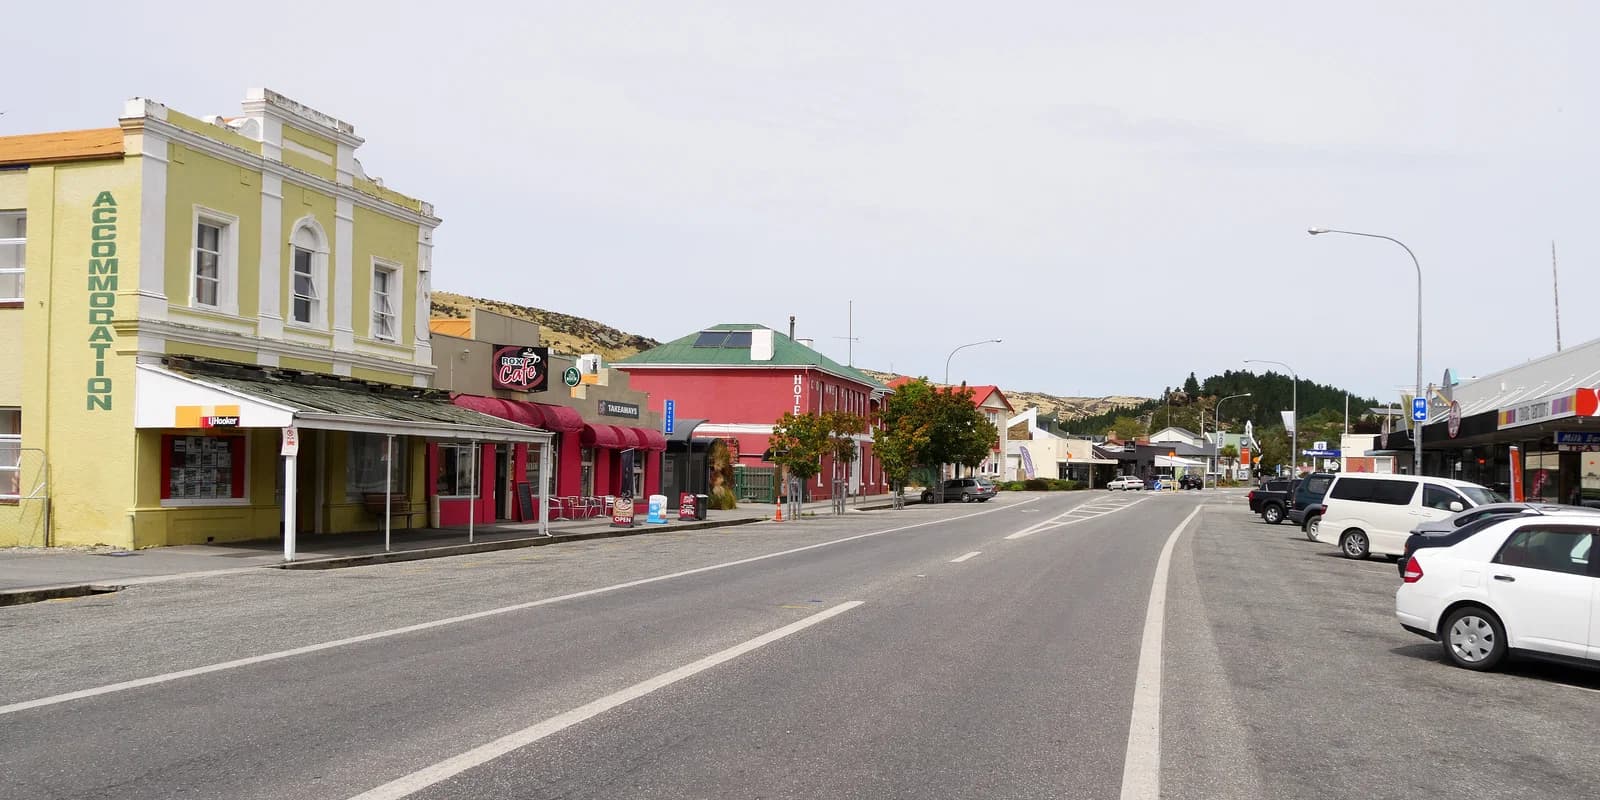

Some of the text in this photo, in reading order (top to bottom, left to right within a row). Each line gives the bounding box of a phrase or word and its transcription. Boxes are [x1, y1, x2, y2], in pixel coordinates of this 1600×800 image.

[87, 190, 119, 411] ACCOMMODATION
[500, 358, 537, 386] Cafe
[607, 404, 638, 415] TAKEAWAYS
[793, 374, 802, 418] HOTE
